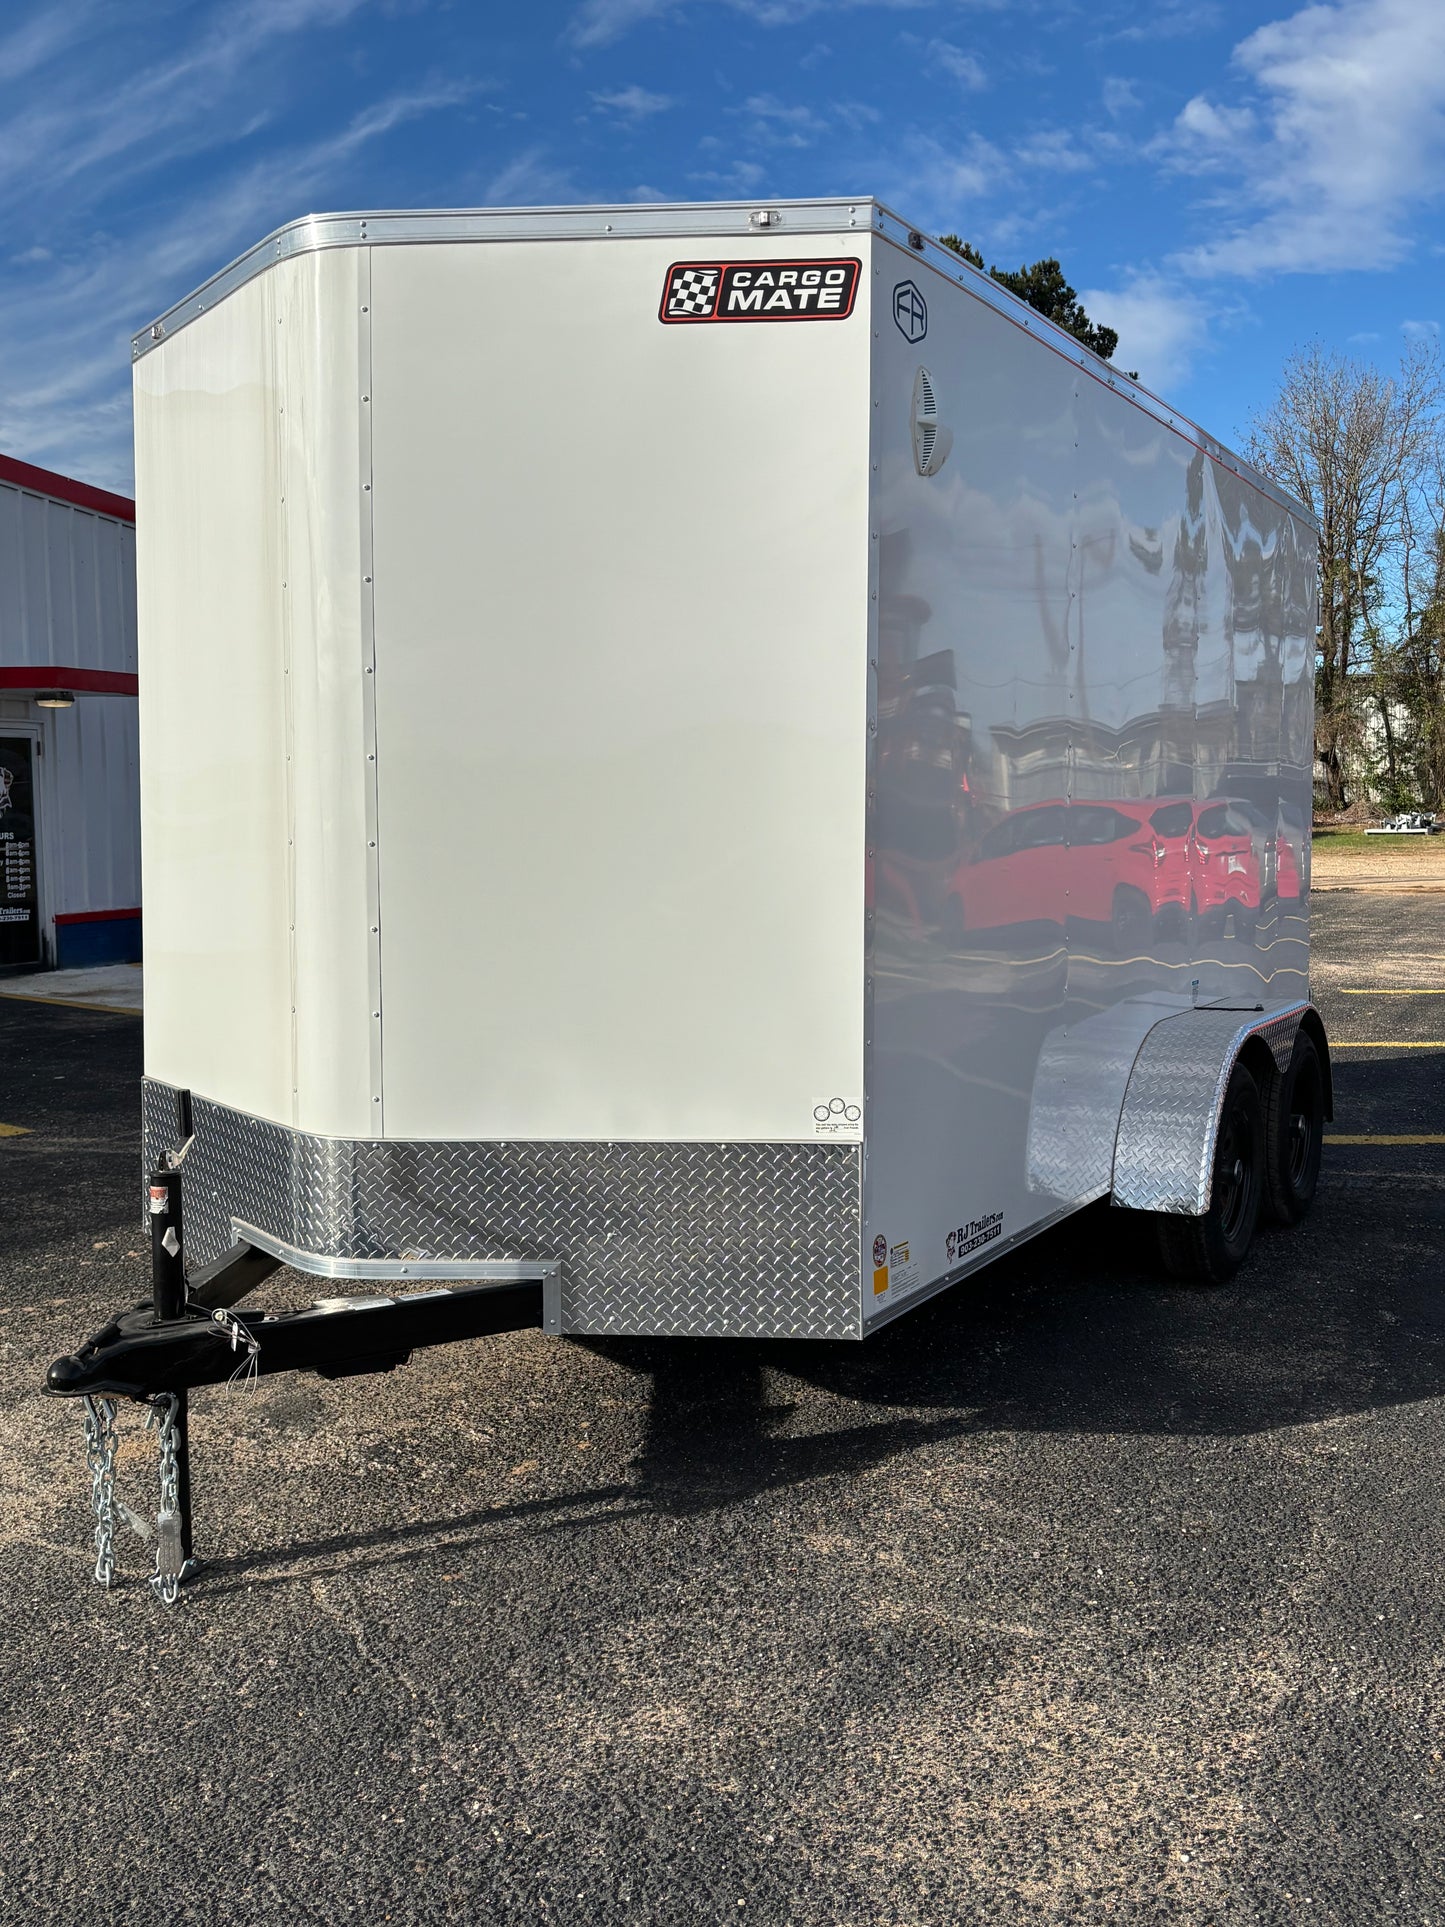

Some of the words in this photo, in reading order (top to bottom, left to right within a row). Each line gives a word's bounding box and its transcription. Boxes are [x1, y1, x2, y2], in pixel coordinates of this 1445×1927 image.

[732, 269, 846, 288] CARGO
[727, 287, 843, 311] MATE
[957, 1223, 969, 1243] RJ
[960, 1224, 1001, 1256] 903-230-7511
